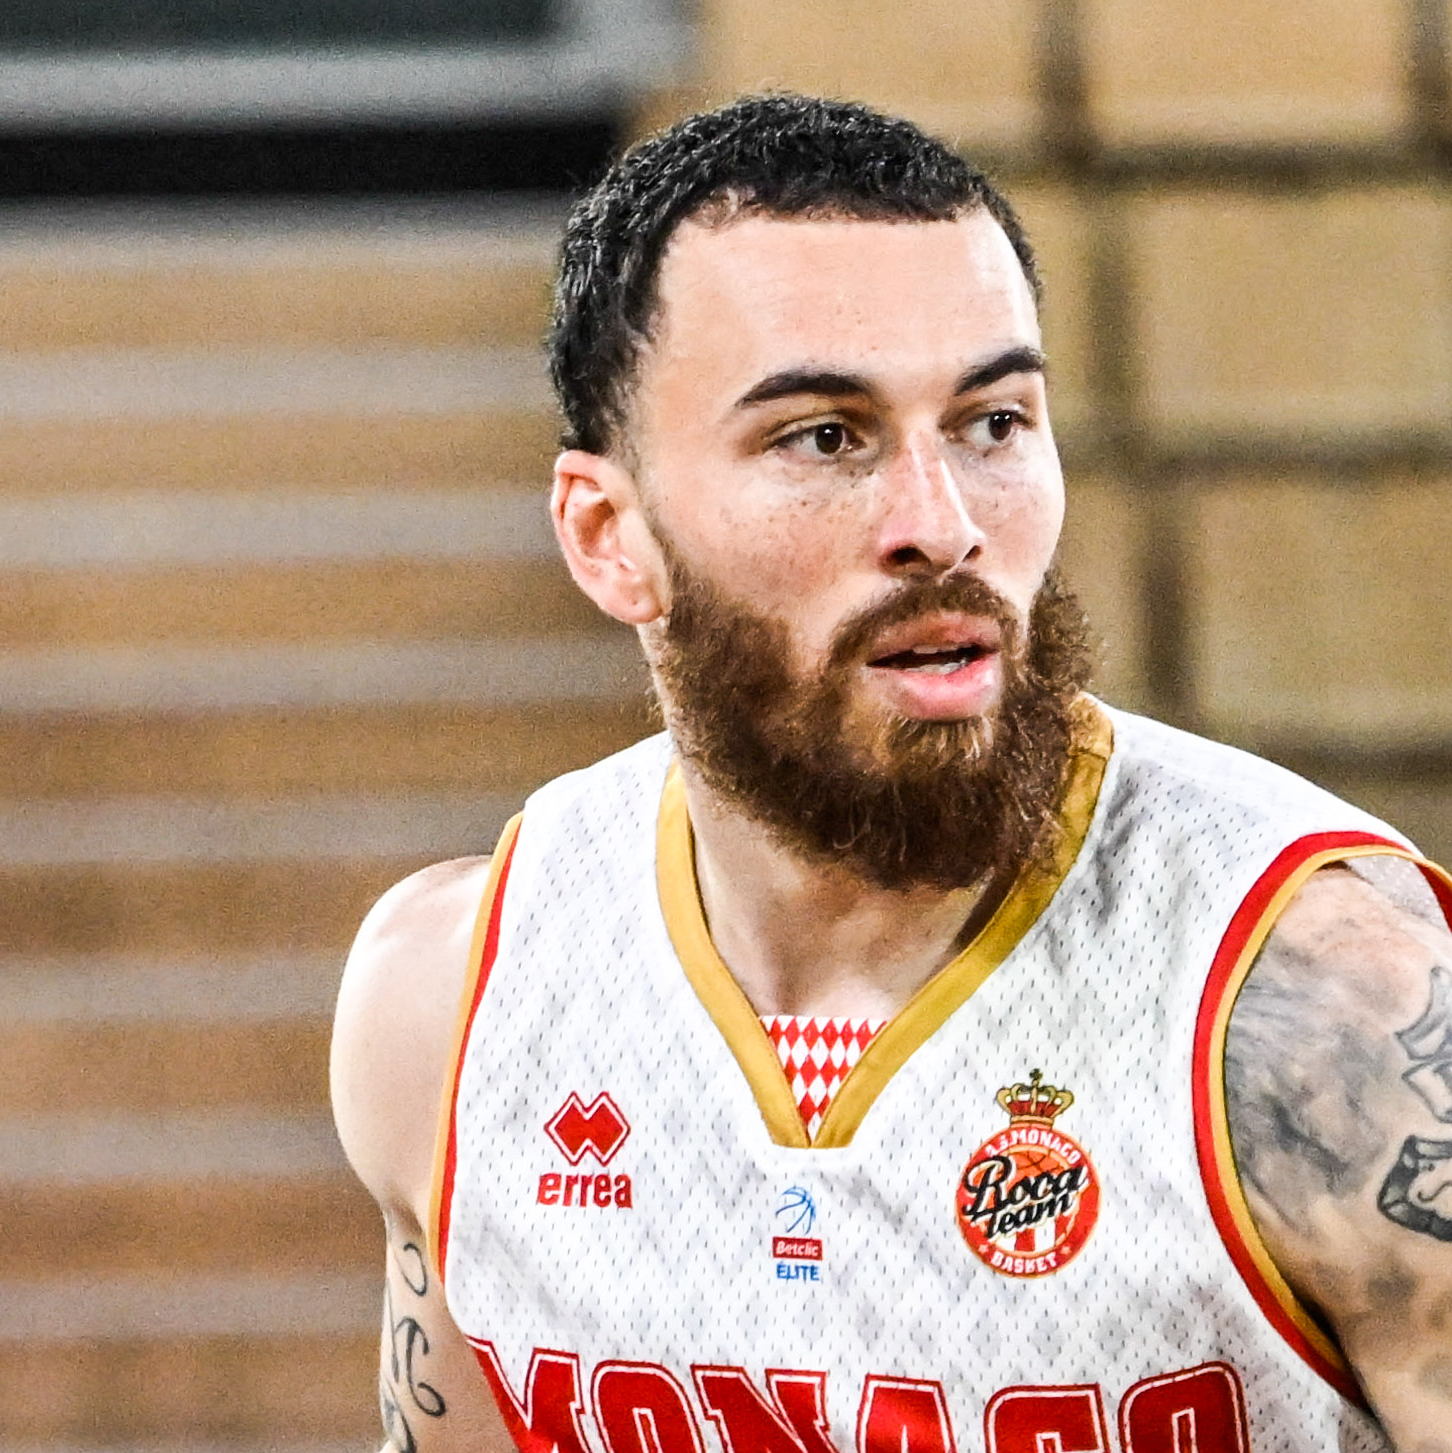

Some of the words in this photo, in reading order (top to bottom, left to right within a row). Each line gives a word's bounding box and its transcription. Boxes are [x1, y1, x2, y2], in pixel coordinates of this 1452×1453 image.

[536, 1172, 633, 1209] errea
[962, 1155, 1088, 1222] Roca
[775, 1240, 819, 1258] Betclic
[990, 1251, 1058, 1274] BASKET
